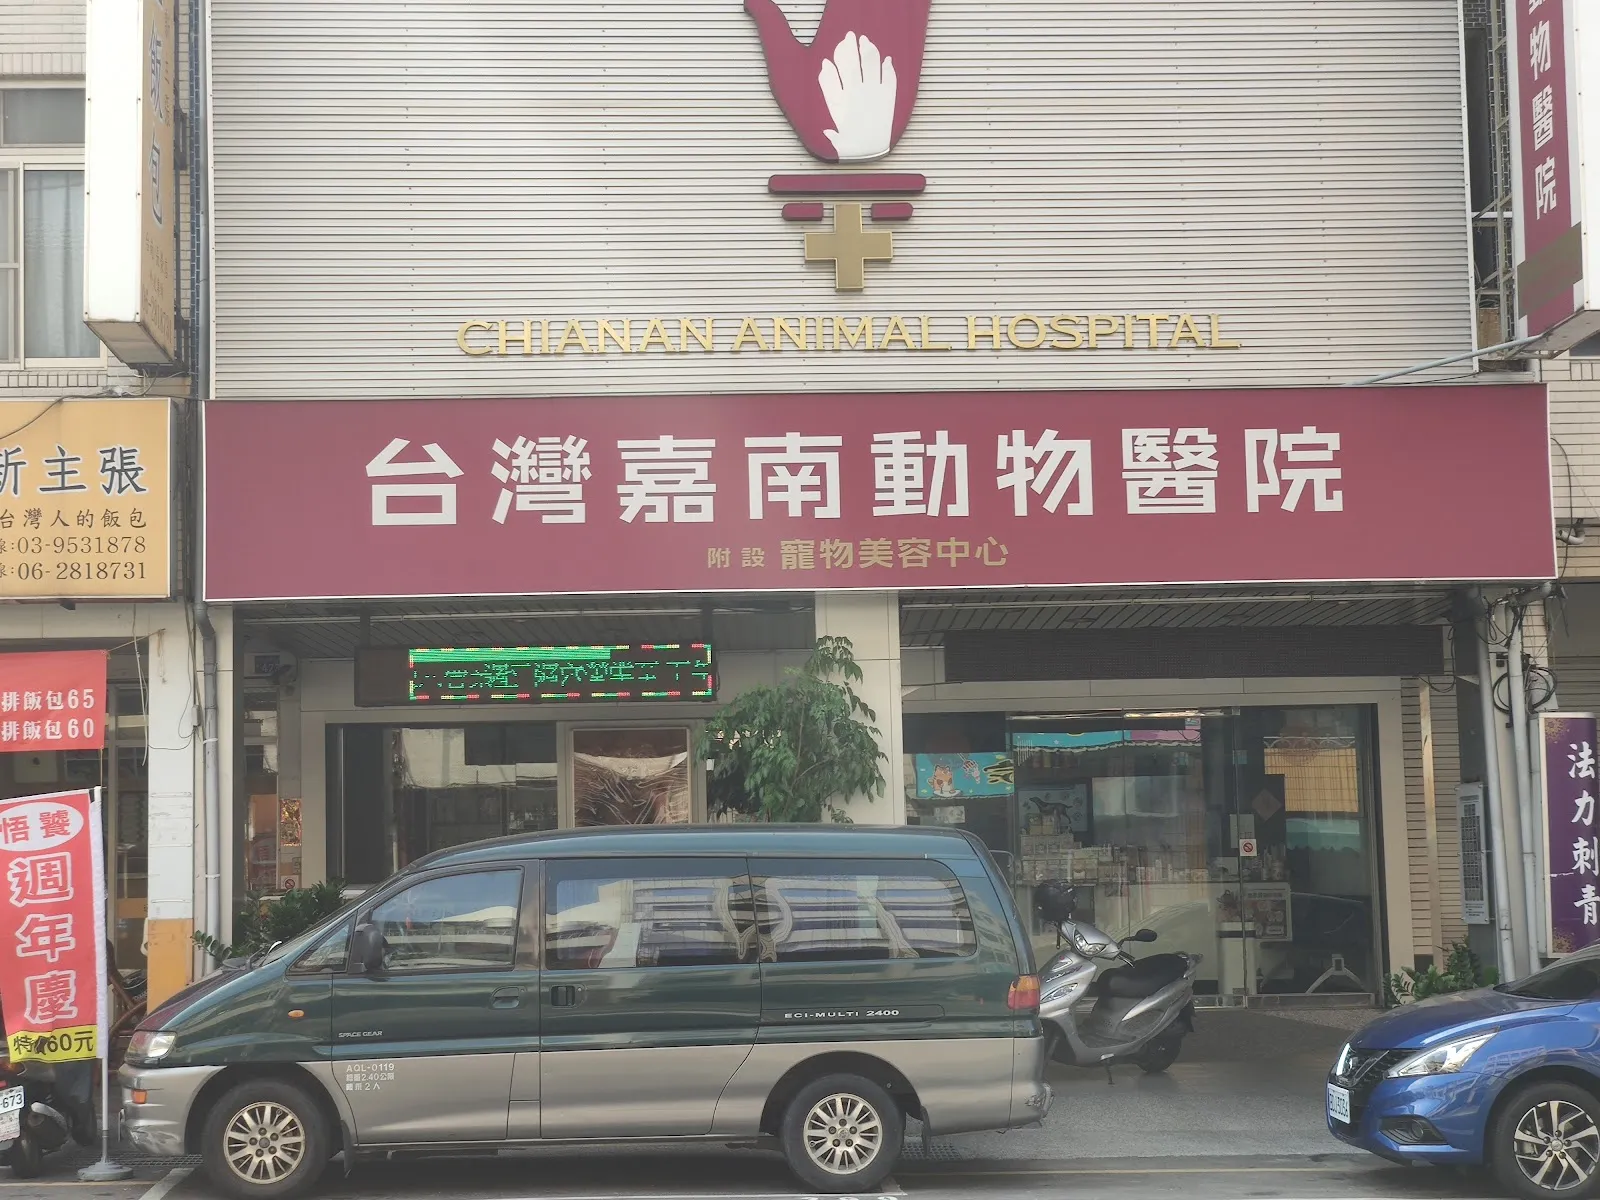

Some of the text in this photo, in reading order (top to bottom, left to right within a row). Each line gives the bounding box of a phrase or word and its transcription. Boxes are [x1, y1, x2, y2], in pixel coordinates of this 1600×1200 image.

[147, 0, 166, 227] 飯包
[1528, 0, 1557, 221] 物醫院
[457, 313, 1241, 355] CHIANAN ANIMAL HOSPITAL
[365, 426, 1344, 526] 台灣嘉南動物醫院
[0, 508, 147, 530] 台灣人的飯包
[707, 536, 1009, 570] 附設 寵物美容中心
[1, 689, 95, 713] 排飯包65
[1, 718, 95, 742] 排飯包60
[1567, 741, 1600, 926] 法力刺青
[8, 851, 78, 1025] 週年慶
[784, 1009, 900, 1019] ECI-MULTI 2400
[346, 1063, 395, 1073] AQL-0119
